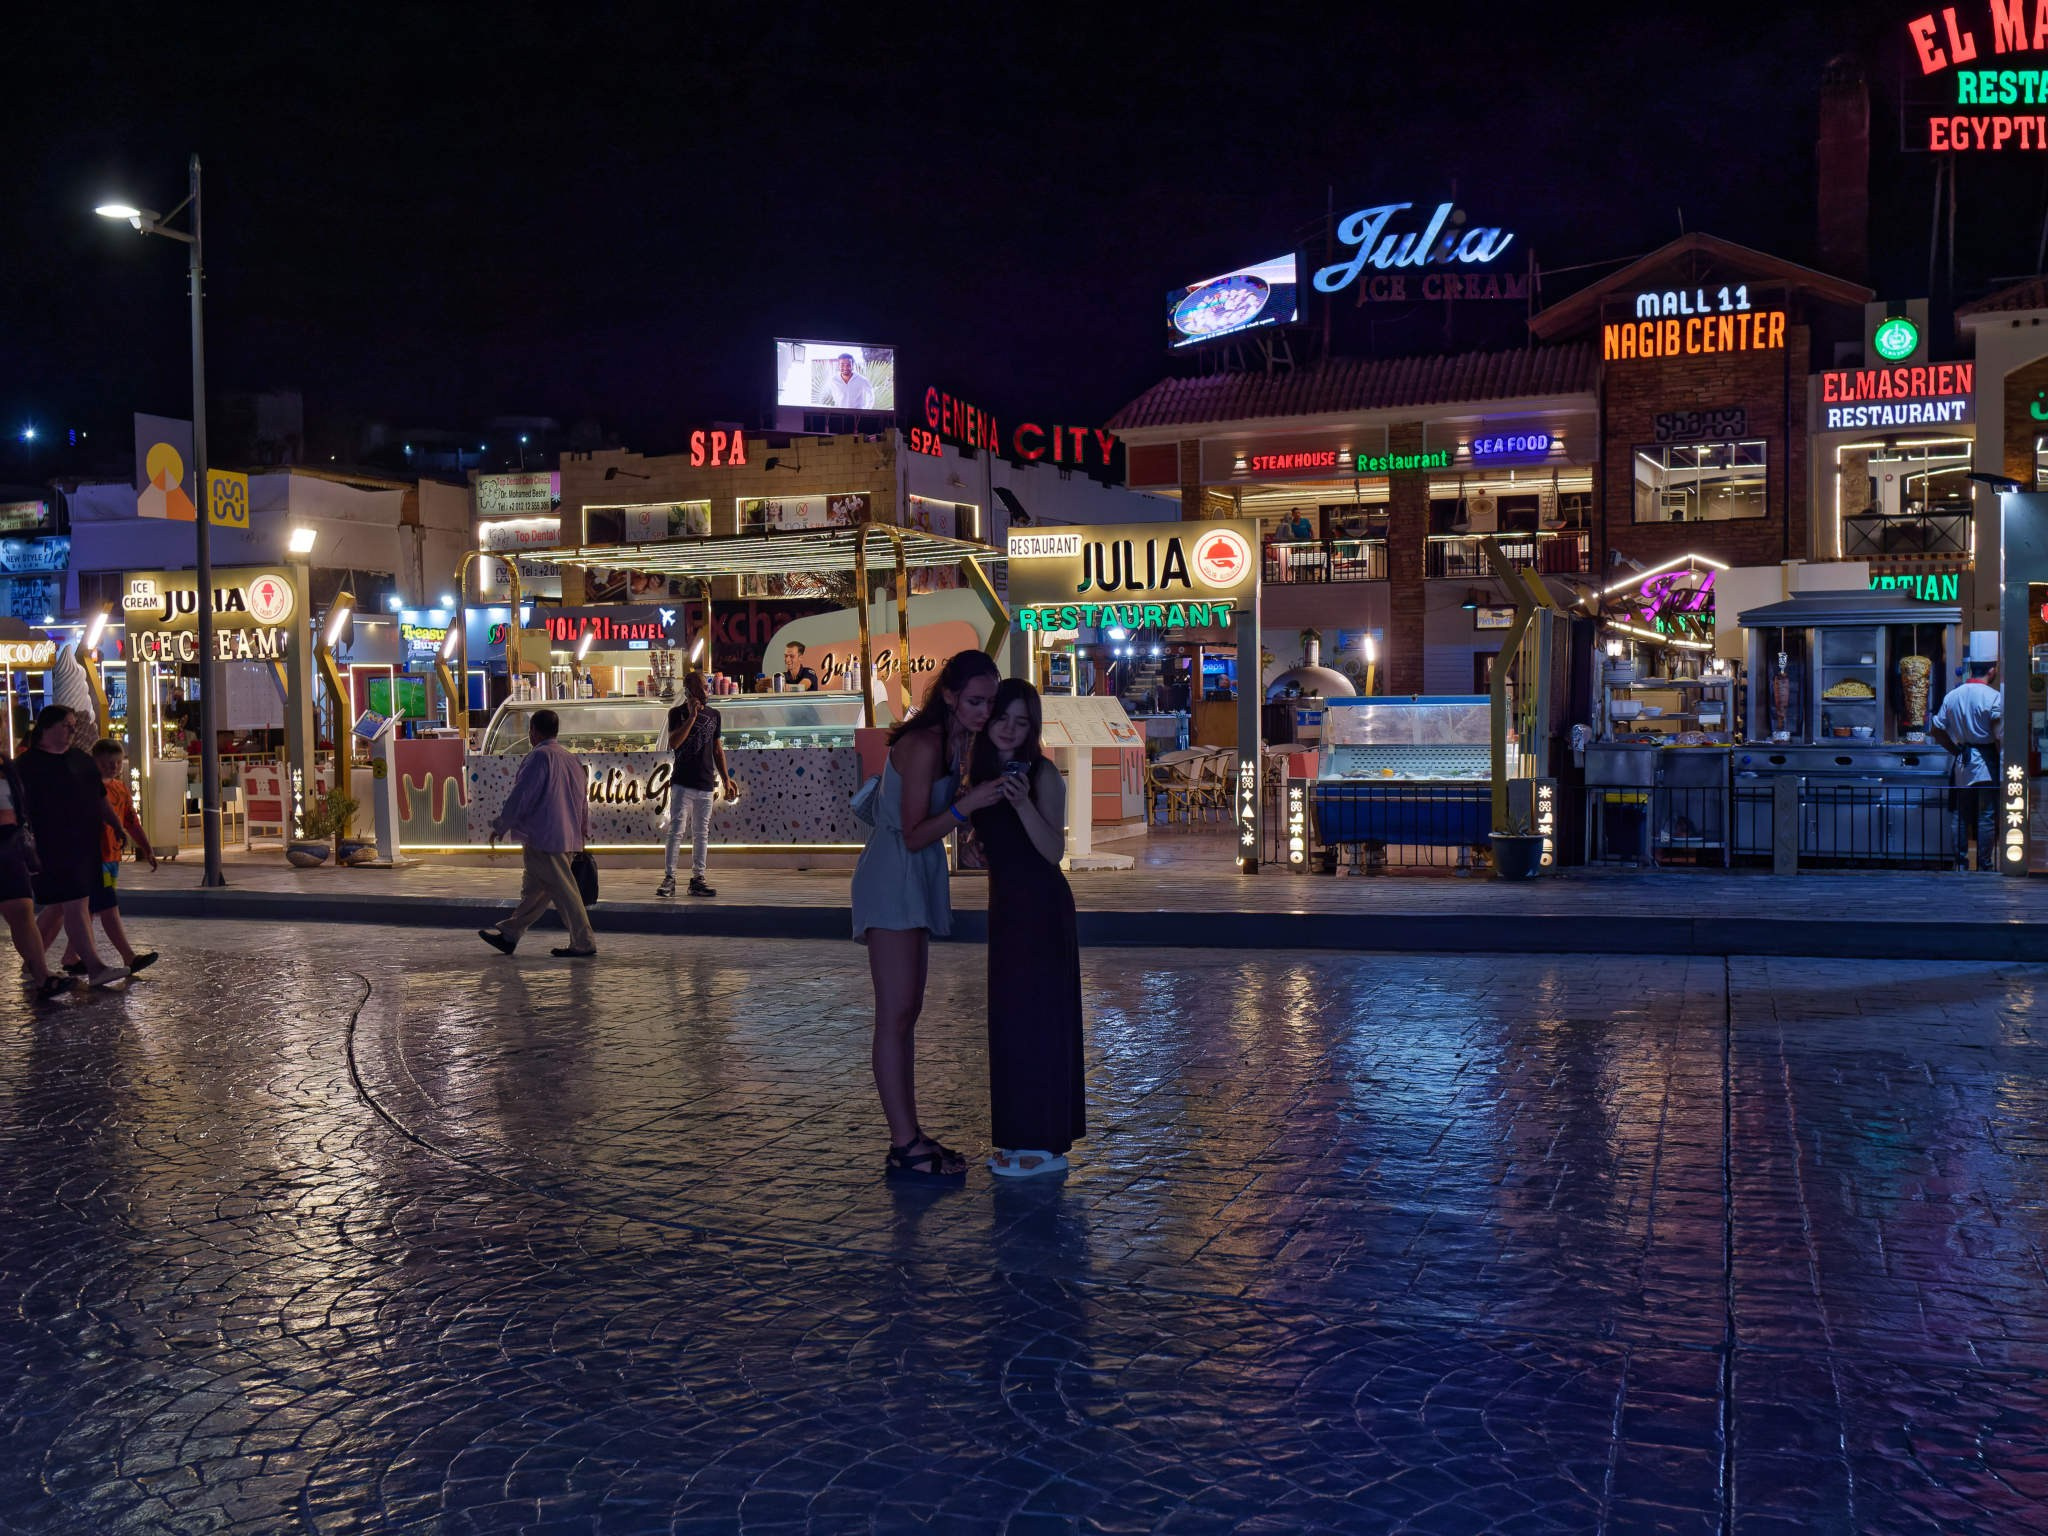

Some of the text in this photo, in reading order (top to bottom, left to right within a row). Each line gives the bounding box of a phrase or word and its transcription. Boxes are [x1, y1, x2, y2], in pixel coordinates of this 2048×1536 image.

[1908, 8, 1977, 75] EL
[1313, 202, 1513, 293] Julia
[1358, 271, 1531, 303] ICE CREAM
[1636, 285, 1751, 318] MALL 11
[1604, 311, 1786, 360] NAGIB CENTER
[1823, 364, 1973, 402] ELMASRIEN
[925, 386, 1116, 465] GENENA CITY
[1828, 401, 1965, 428] RESTAURANT
[690, 430, 746, 467] SPA
[911, 427, 944, 457] SPA
[1507, 435, 1548, 453] FOOD
[1357, 450, 1448, 472] Restaurant
[515, 528, 556, 543] Top Dental
[1010, 536, 1079, 556] RESTAURANT
[6, 554, 20, 563] NEW
[522, 566, 534, 577] Tel
[1077, 537, 1192, 593] JULIA
[132, 582, 149, 593] ICE
[123, 597, 158, 608] CREAM
[159, 588, 246, 622] JUIA
[401, 624, 448, 641] Treasu
[612, 623, 665, 640] TRAVEL
[1019, 604, 1231, 632] RESTAURANT
[583, 765, 640, 804] ulia
